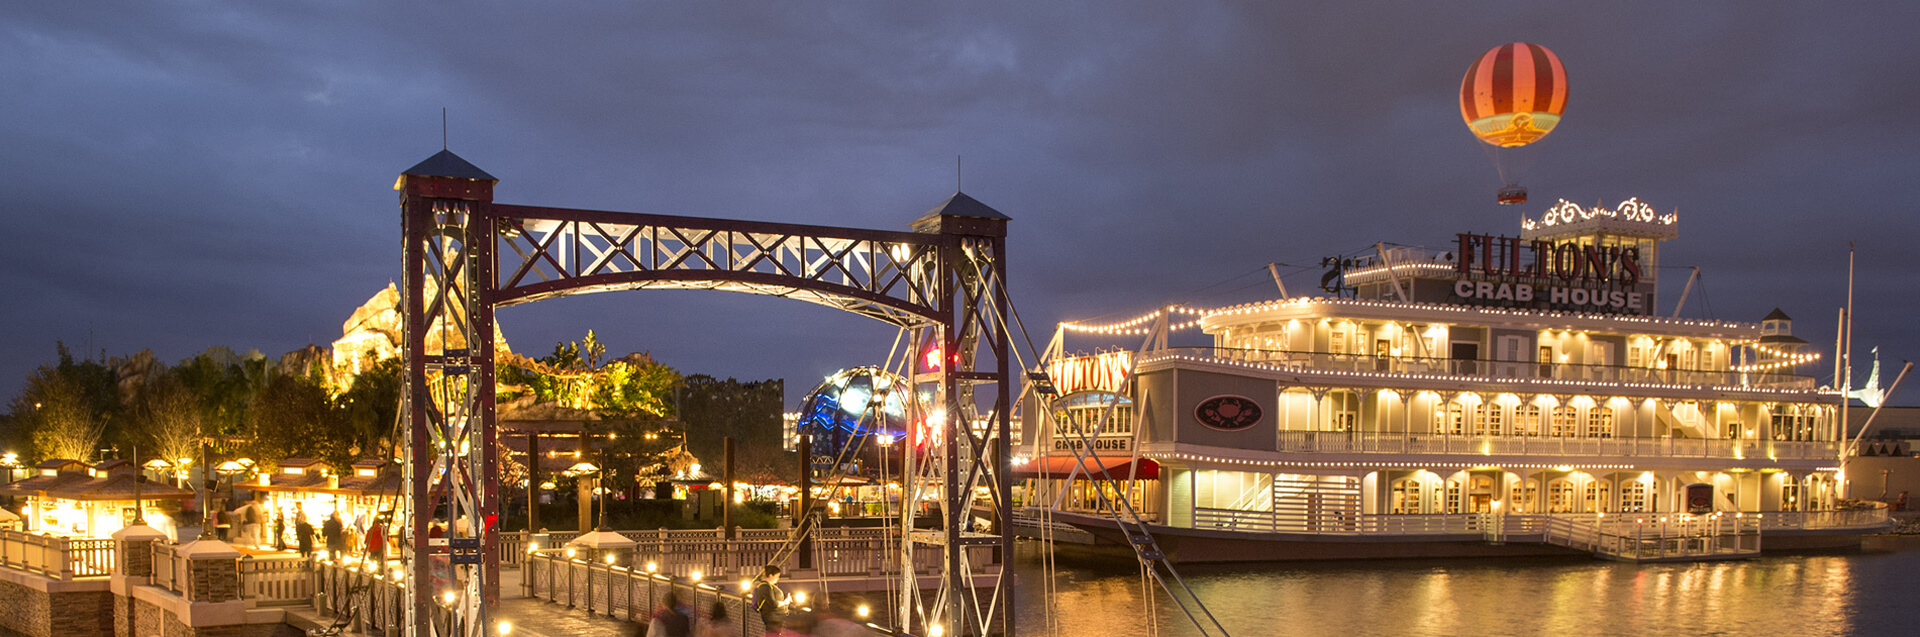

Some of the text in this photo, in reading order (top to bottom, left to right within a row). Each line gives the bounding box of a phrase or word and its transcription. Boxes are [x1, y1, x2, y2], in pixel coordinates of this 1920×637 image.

[1455, 233, 1640, 285] FULTON'S
[1454, 280, 1642, 308] CRAB HOUSE
[1051, 352, 1129, 397] FULTON'S
[1087, 439, 1126, 450] OUSE
